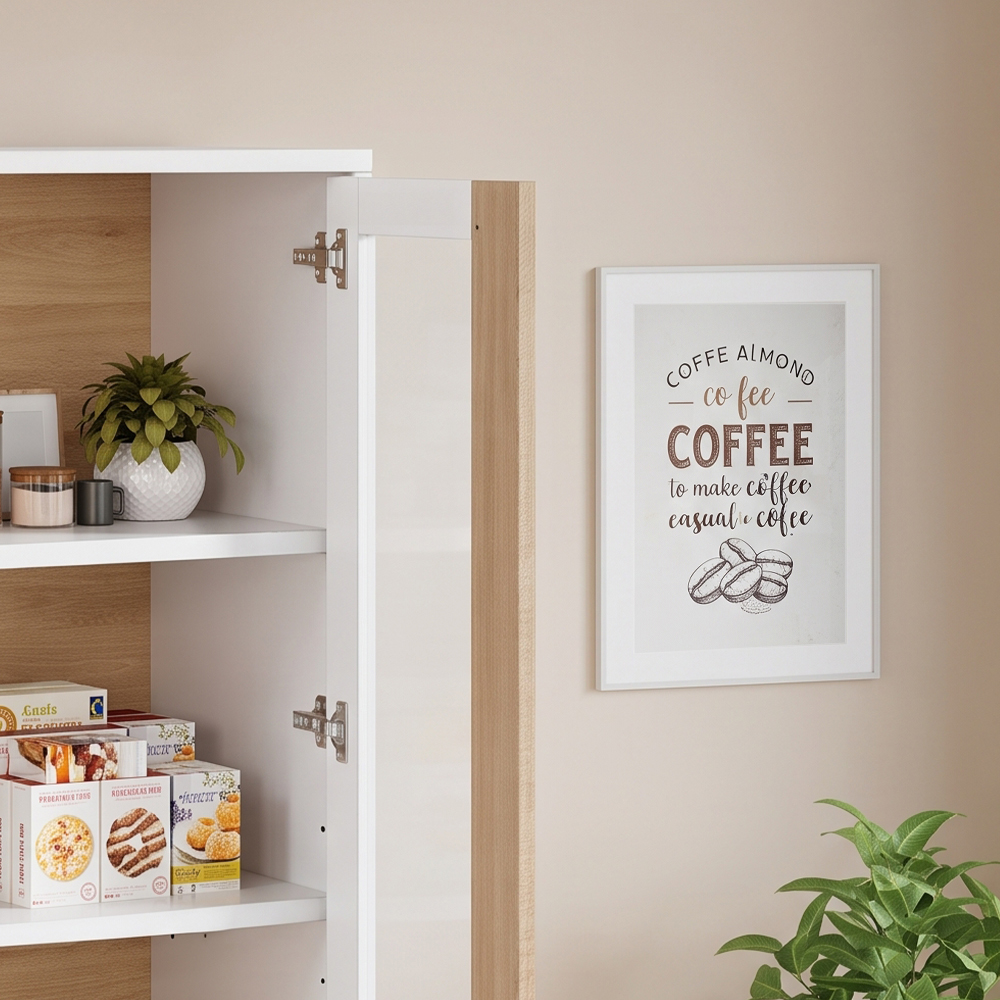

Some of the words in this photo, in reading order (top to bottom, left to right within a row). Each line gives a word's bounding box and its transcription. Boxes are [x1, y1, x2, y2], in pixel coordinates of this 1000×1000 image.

[666, 346, 728, 388] COFFE
[667, 422, 814, 469] COFFEE
[668, 478, 688, 498] to
[693, 475, 742, 497] make
